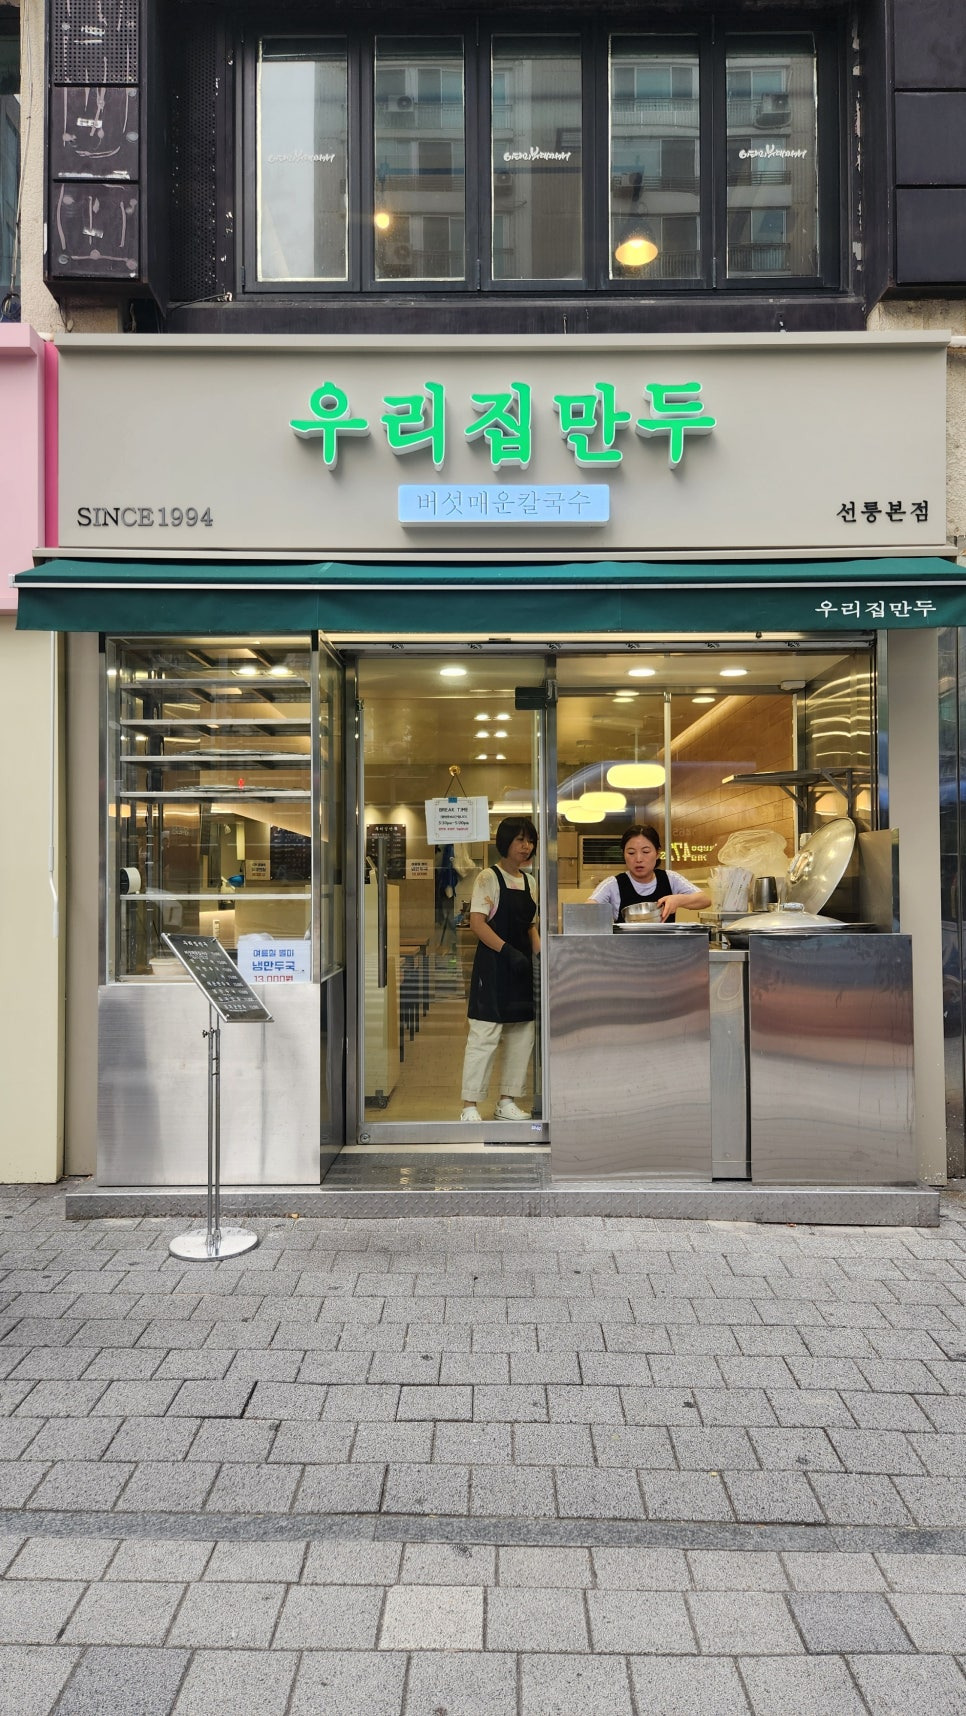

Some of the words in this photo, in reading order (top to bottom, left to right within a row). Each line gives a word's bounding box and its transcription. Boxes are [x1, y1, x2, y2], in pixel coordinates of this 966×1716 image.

[289, 381, 717, 469] 우리집만두
[416, 490, 591, 516] 버섯매운칼국수
[836, 500, 929, 523] 선릉본점
[814, 600, 937, 618] 우리집만두
[252, 960, 295, 972] 냉만두국
